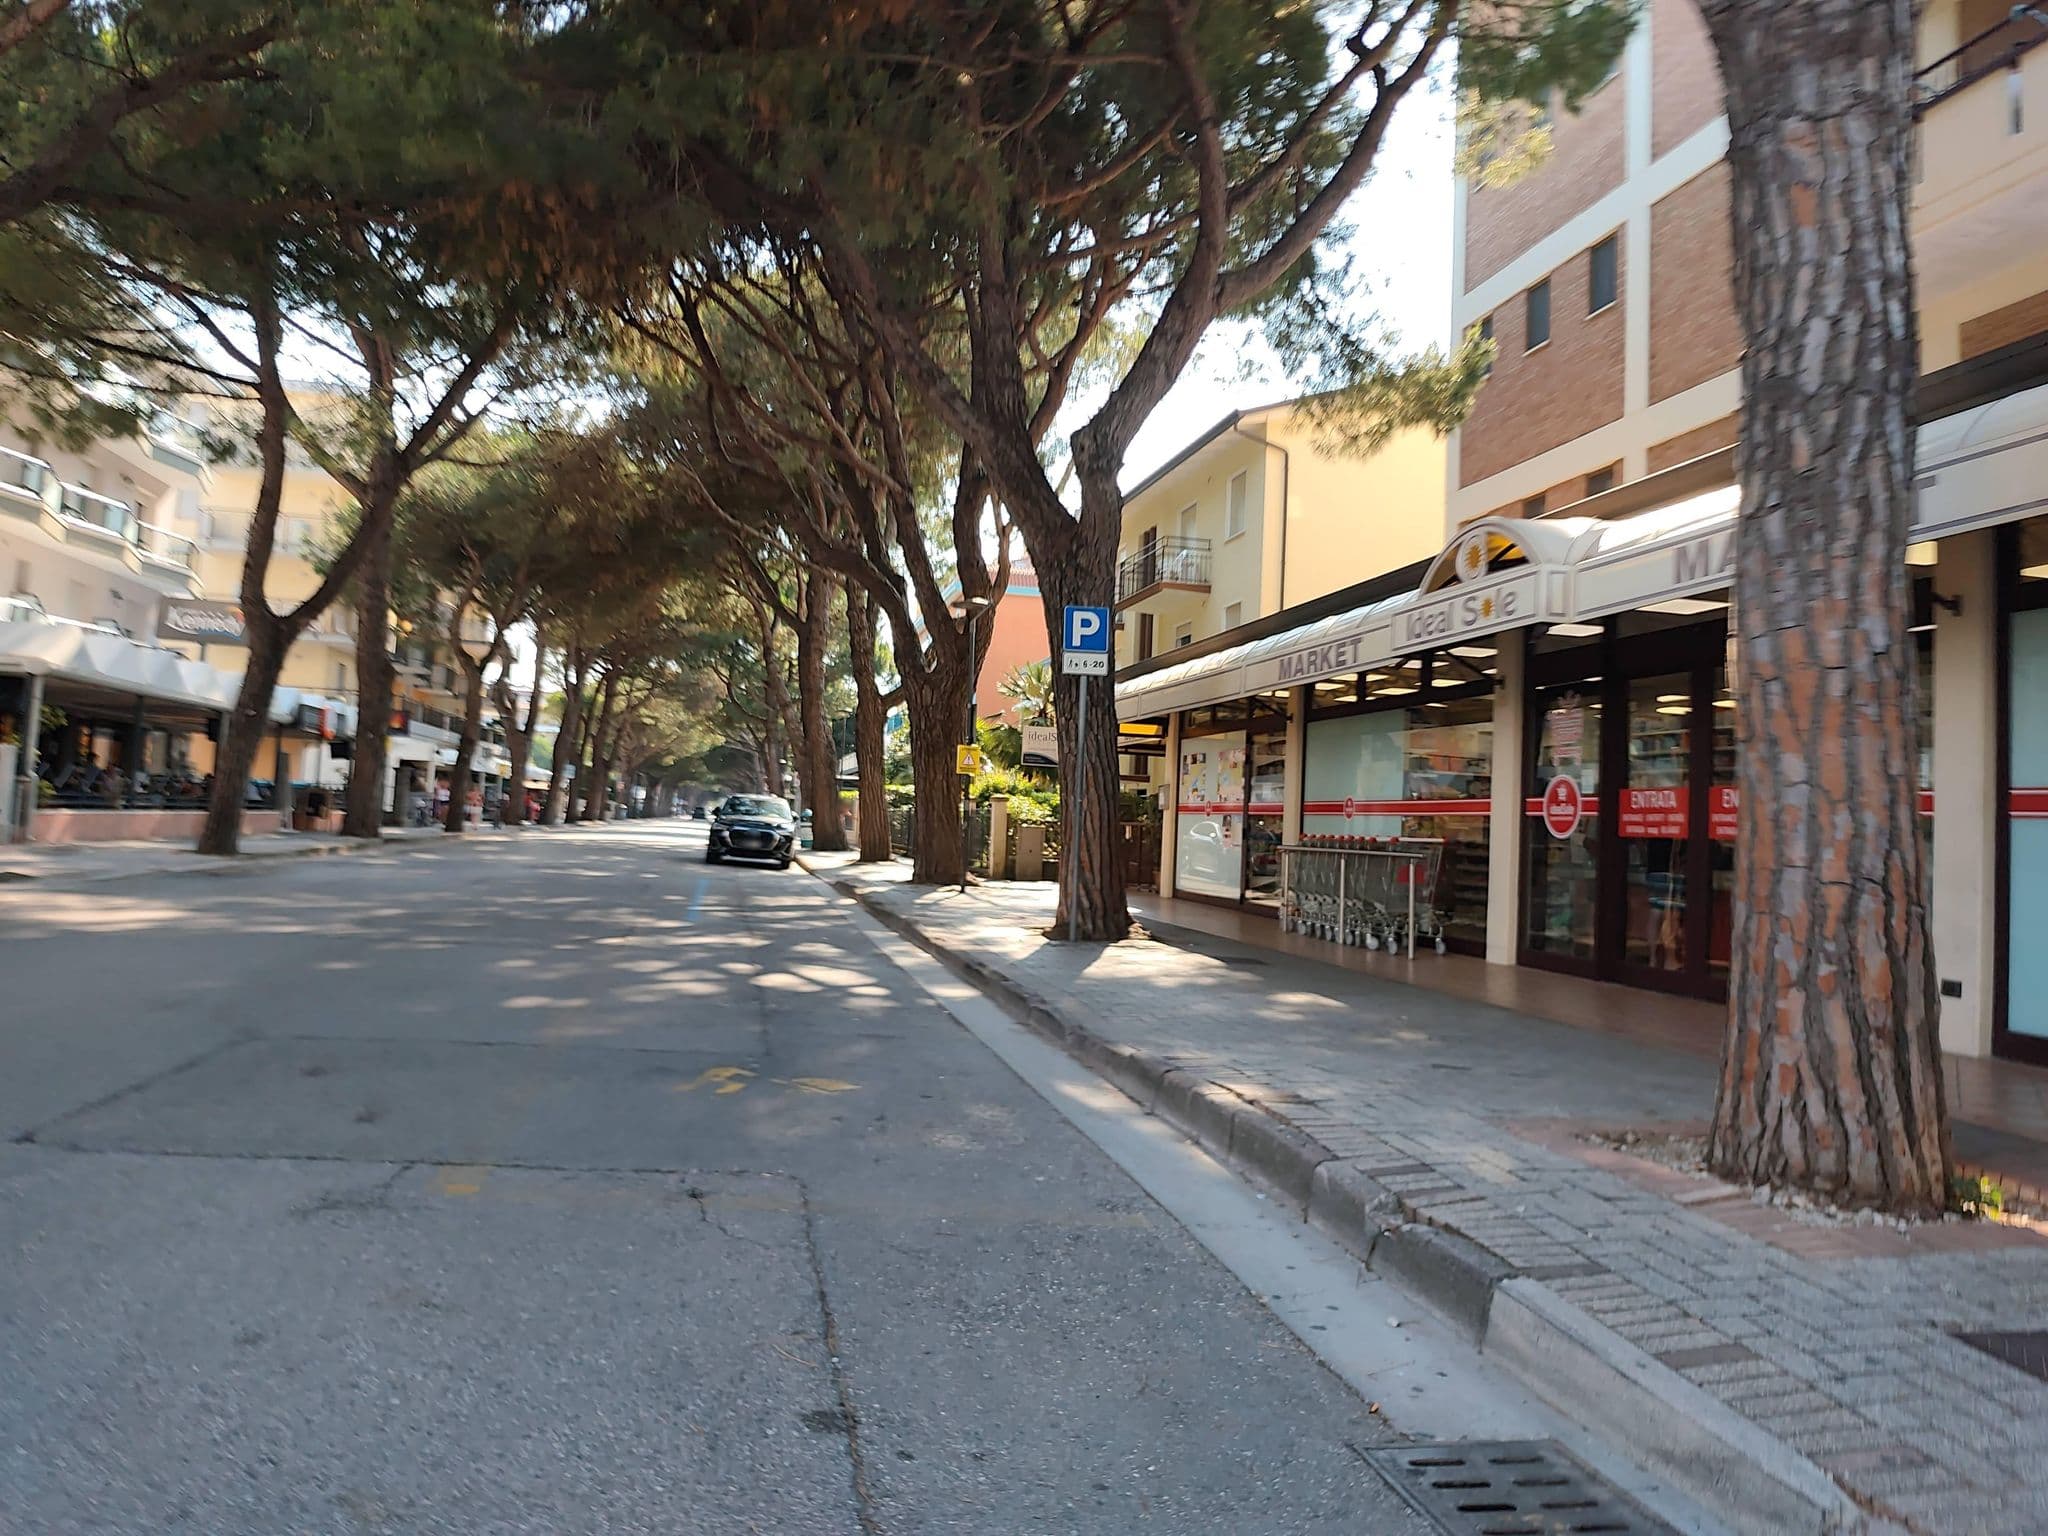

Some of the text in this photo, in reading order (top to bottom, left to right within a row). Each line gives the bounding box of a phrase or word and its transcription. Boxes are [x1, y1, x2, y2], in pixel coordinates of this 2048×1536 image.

[1072, 611, 1100, 646] P
[1408, 601, 1454, 641] Ideal
[1279, 637, 1362, 680] MARKET
[1028, 731, 1057, 741] idealS
